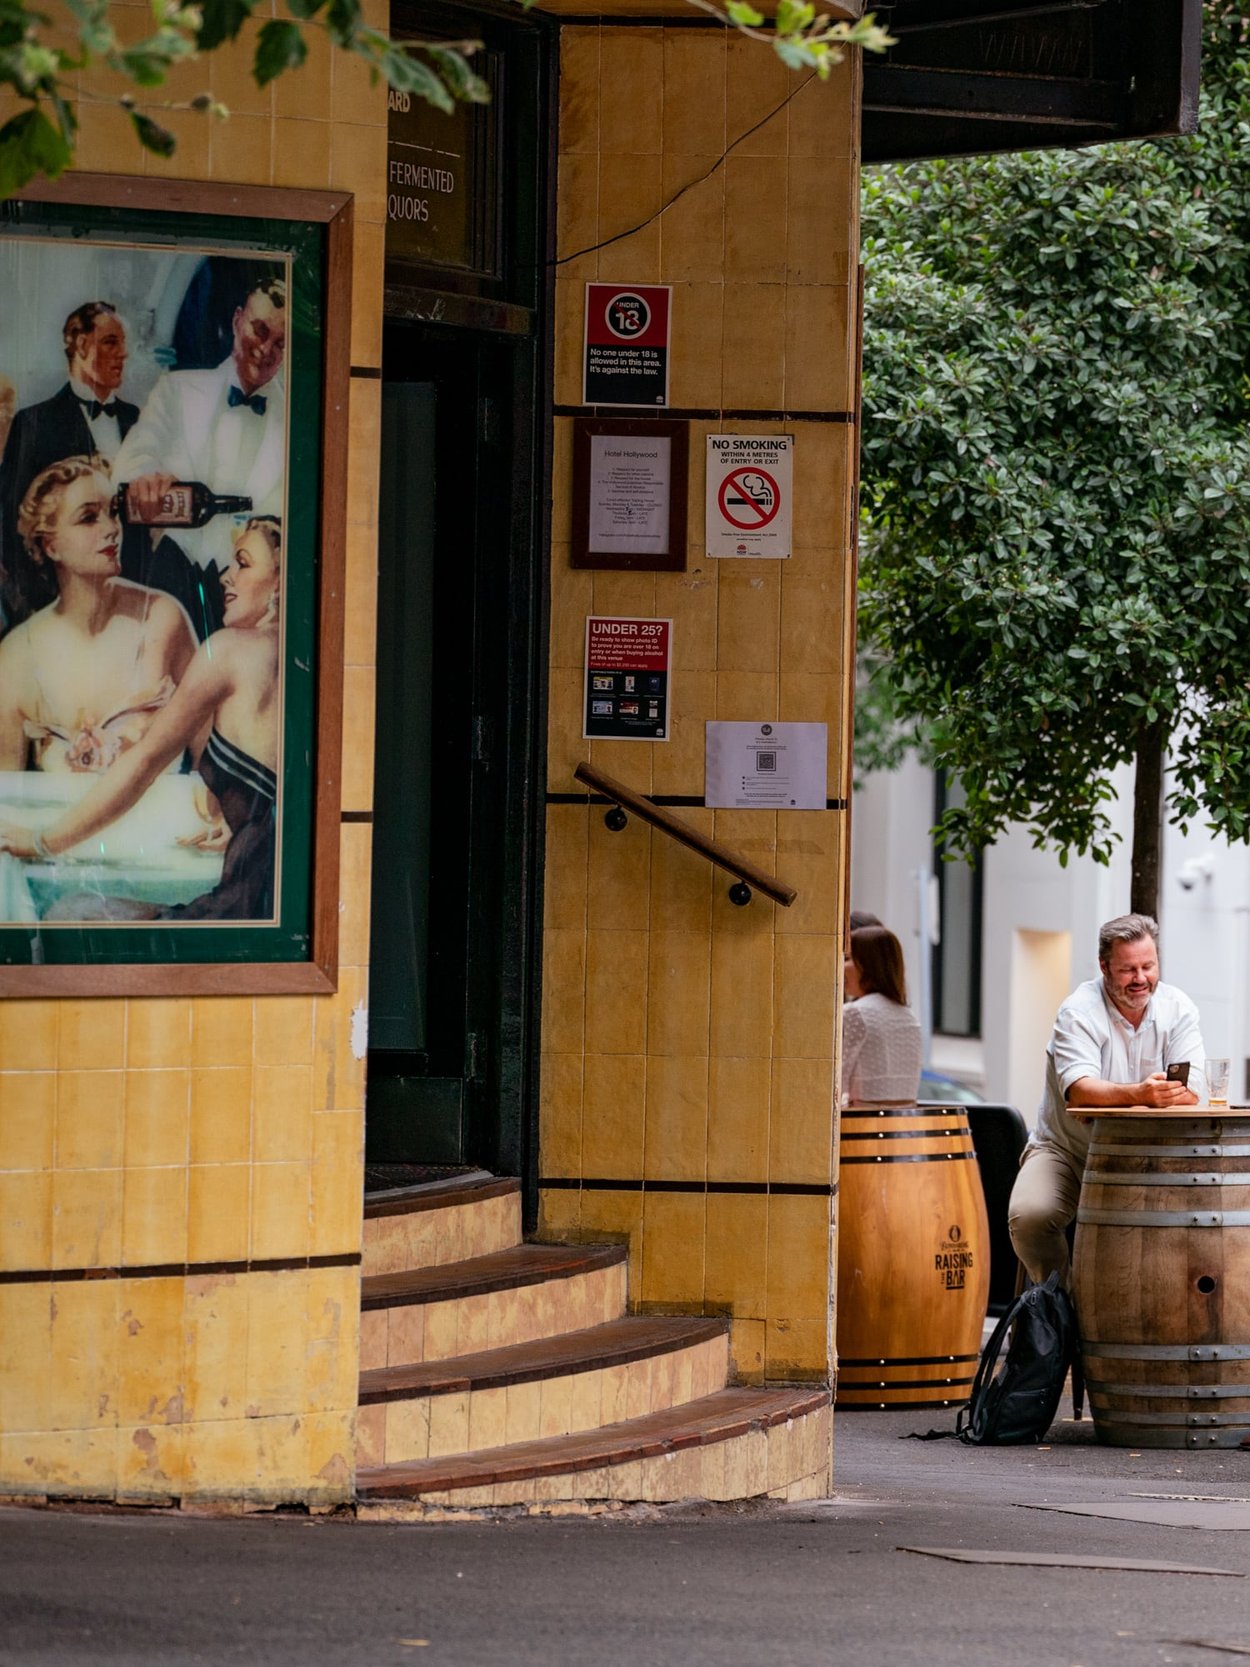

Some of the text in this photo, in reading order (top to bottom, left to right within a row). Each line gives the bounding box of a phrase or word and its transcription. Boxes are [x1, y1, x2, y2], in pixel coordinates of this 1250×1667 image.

[390, 161, 454, 194] FERMENTED
[388, 194, 429, 222] QUORS
[616, 310, 640, 330] 18
[590, 348, 601, 356] No
[590, 357, 618, 365] allowed
[628, 358, 642, 366] this
[602, 366, 629, 375] against
[712, 440, 787, 450] NO SMOKING
[592, 623, 663, 635] UNDER 25?
[935, 1252, 973, 1270] RAISING
[946, 1270, 965, 1285] BAR
